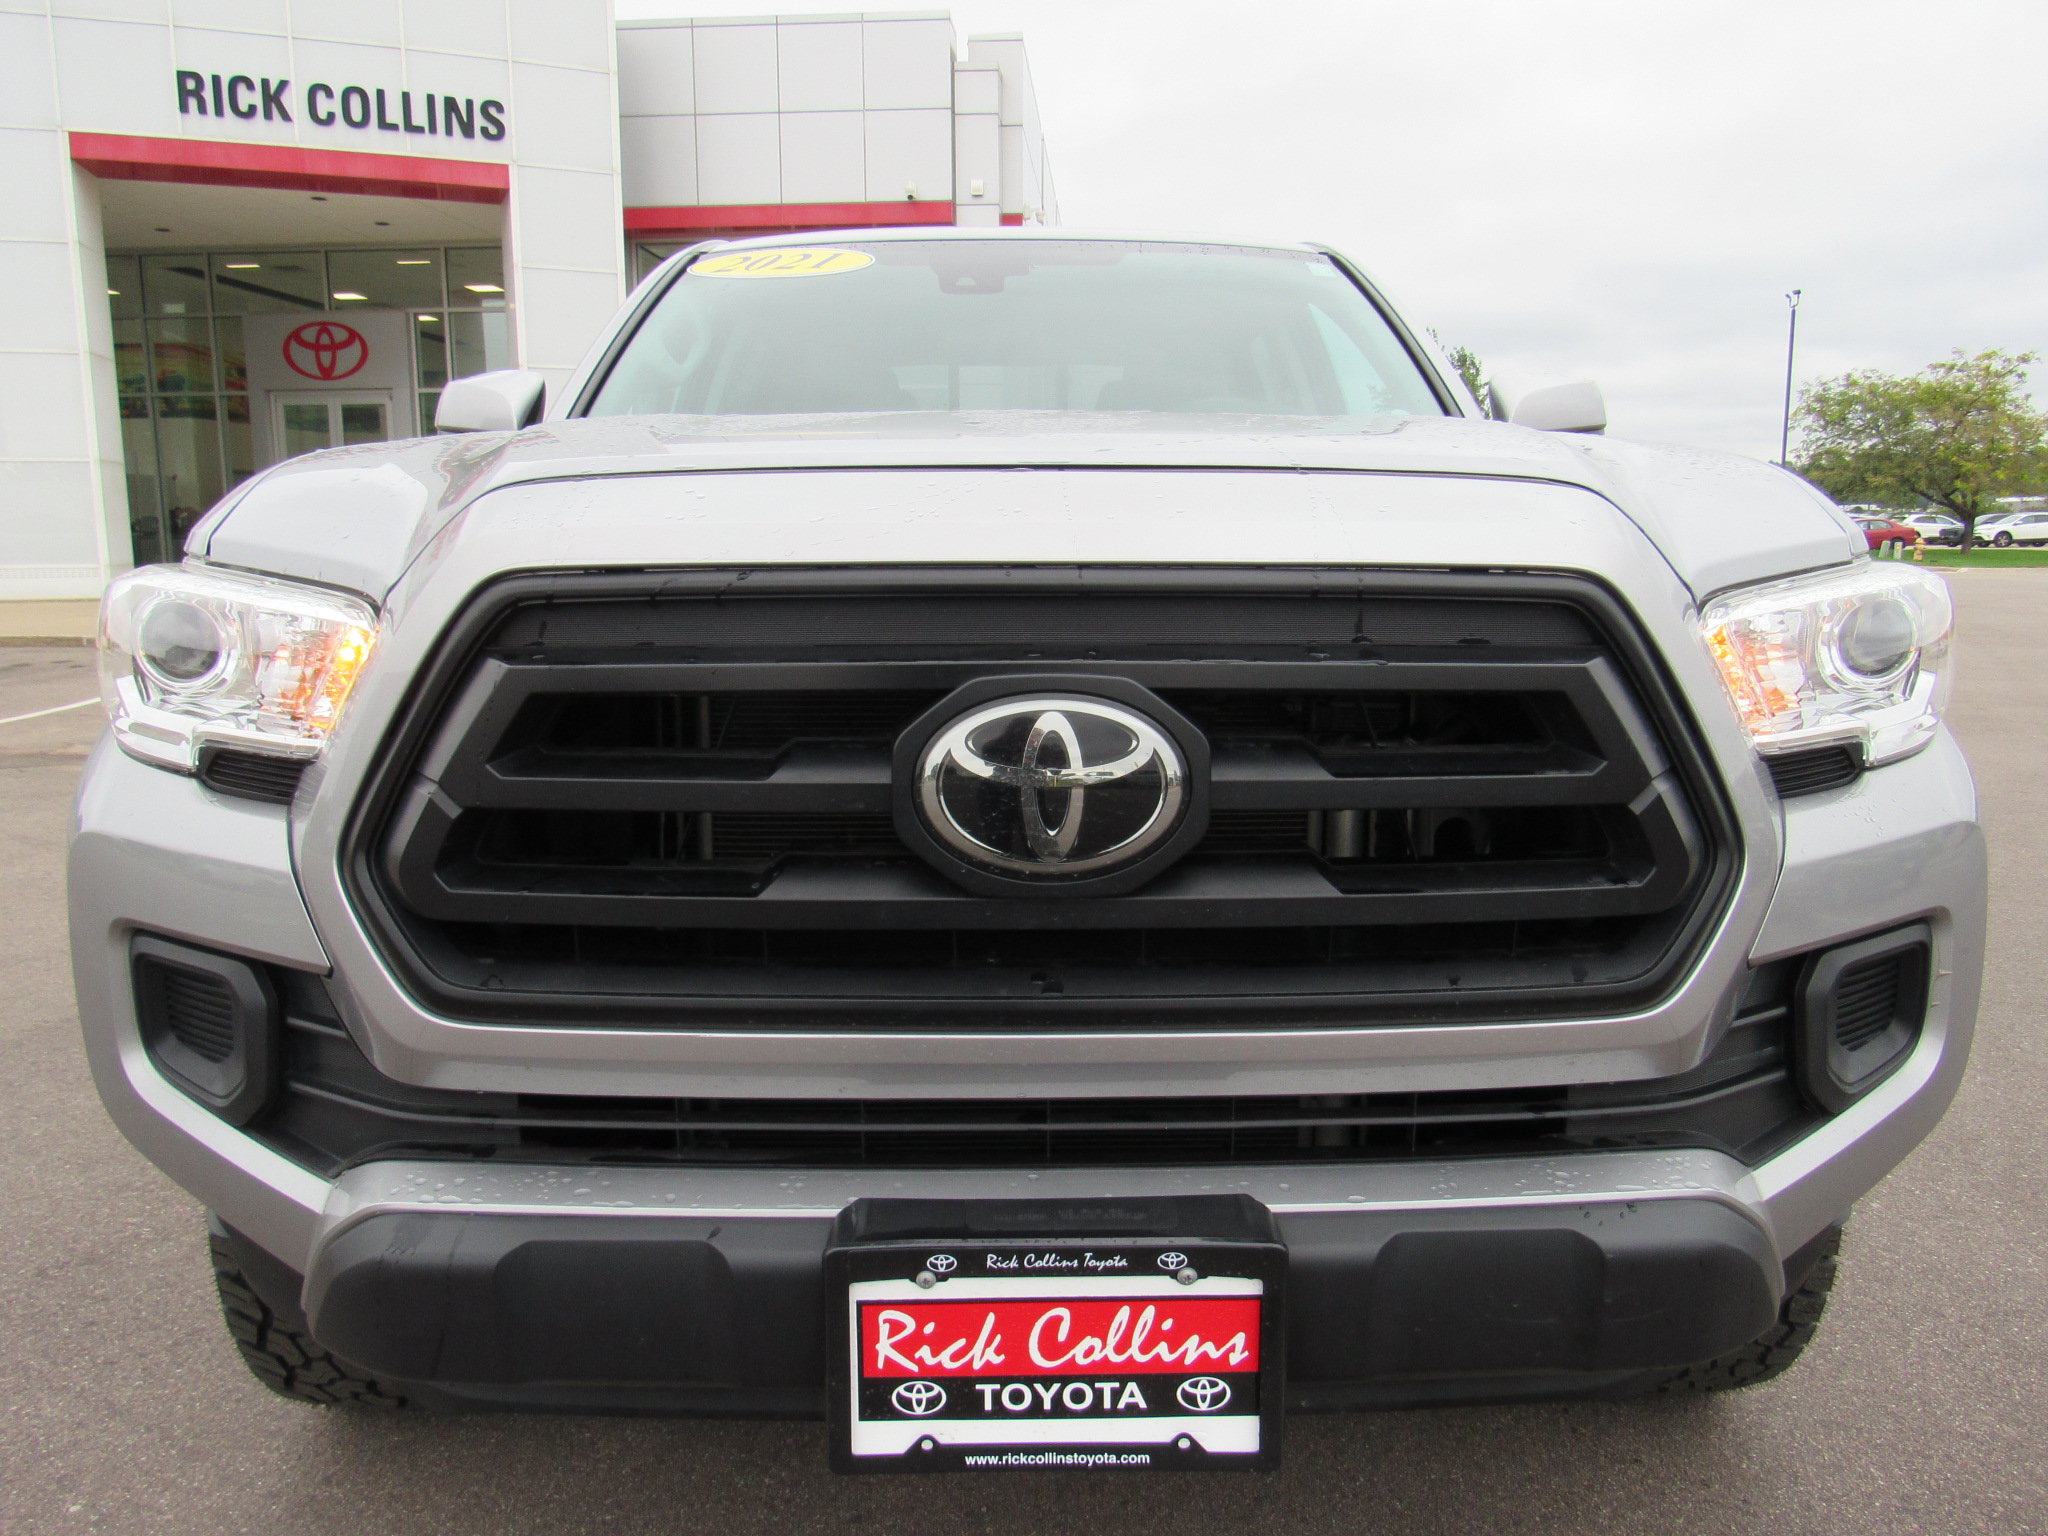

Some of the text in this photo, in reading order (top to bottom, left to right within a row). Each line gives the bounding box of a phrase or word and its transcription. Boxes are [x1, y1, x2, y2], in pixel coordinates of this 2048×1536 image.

[176, 70, 506, 142] RICK COLLINS
[711, 252, 843, 273] 2021
[986, 1252, 1128, 1271] Rick Collins Toyota
[875, 1304, 1249, 1373] Rick Collins
[975, 1381, 1148, 1412] TOYOTA
[964, 1451, 1150, 1468] www.rickcollinstoyota.com
